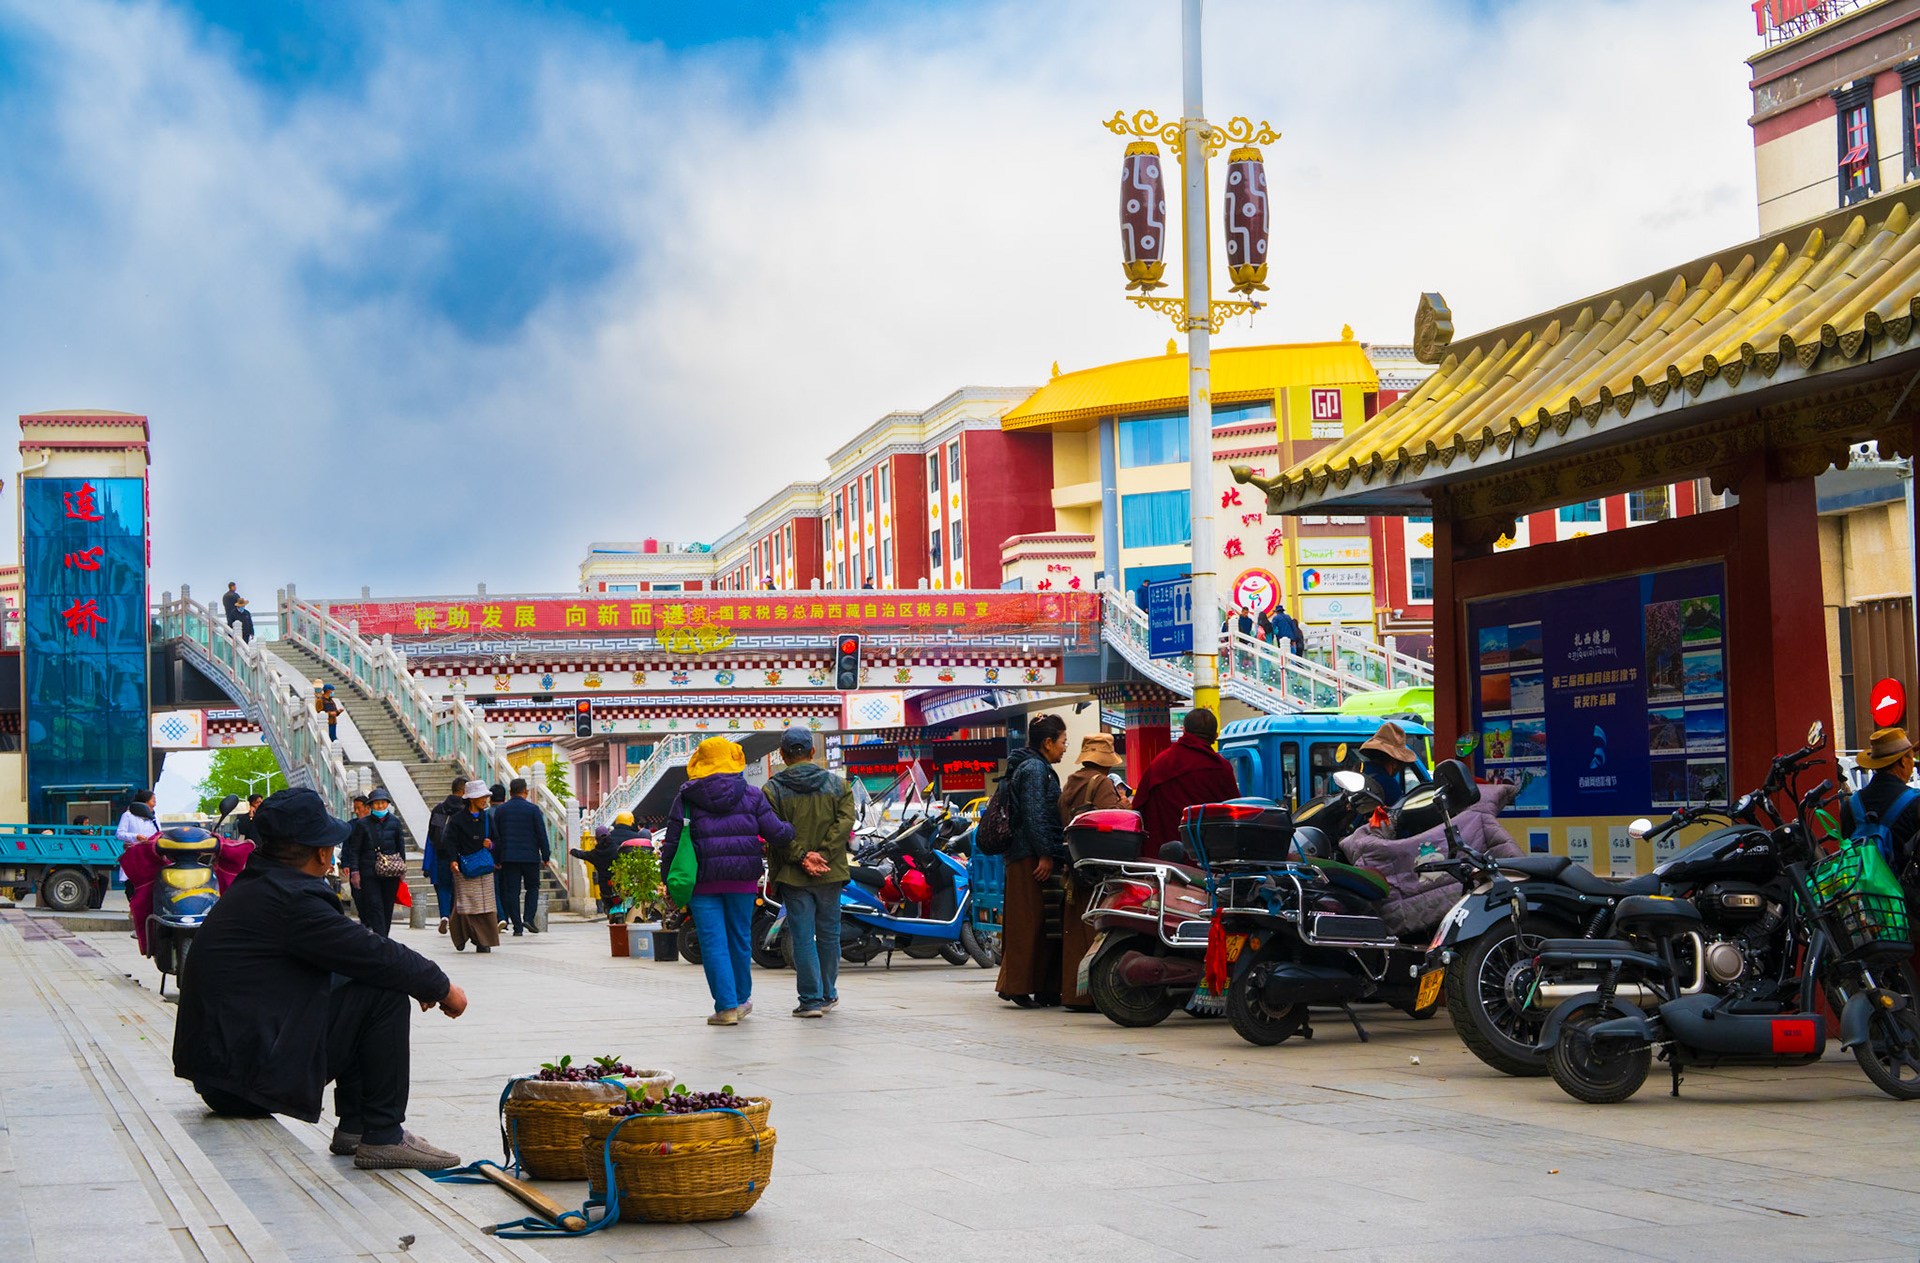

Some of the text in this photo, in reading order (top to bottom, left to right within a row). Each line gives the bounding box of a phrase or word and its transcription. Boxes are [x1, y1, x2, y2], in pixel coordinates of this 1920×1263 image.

[62, 482, 107, 639] 连心桥
[1302, 548, 1334, 559] Dmart
[414, 606, 536, 630] 税助发展
[719, 602, 966, 622] 国家税务总局西藏自治区税务局
[975, 602, 989, 617] 宣
[1574, 629, 1611, 647] 扎西德勒
[1552, 668, 1638, 689] 第三届西藏网络影像节
[1574, 693, 1617, 709] 获奖作品展
